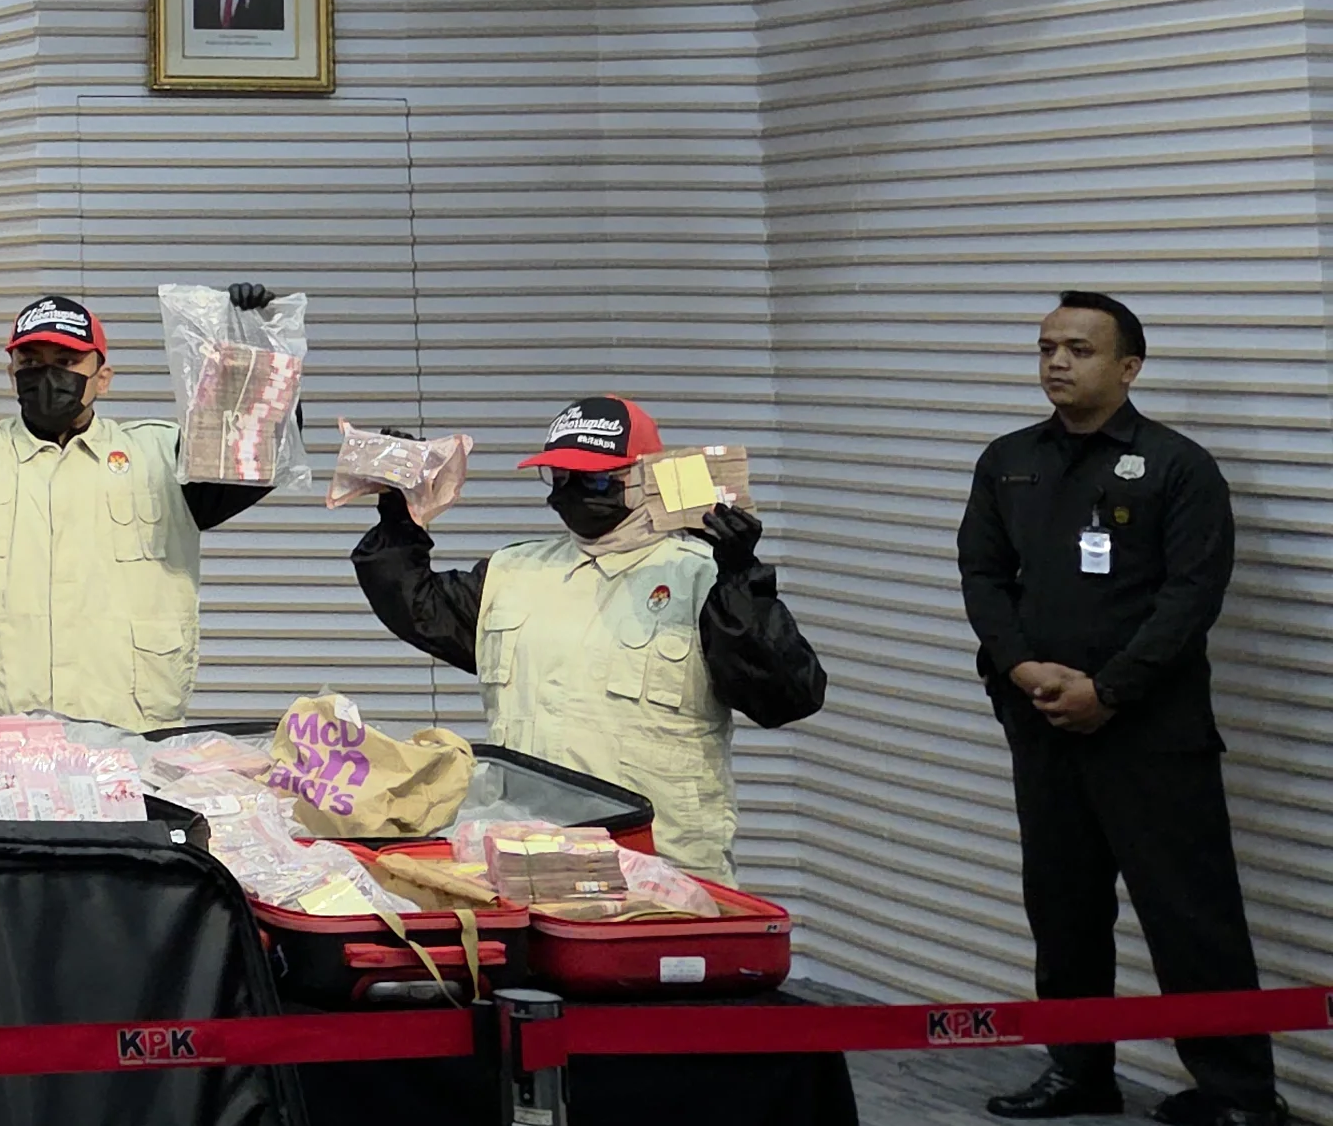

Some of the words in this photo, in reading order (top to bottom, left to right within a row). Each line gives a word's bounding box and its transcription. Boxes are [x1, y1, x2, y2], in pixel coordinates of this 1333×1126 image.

[286, 712, 366, 748] McD
[927, 1008, 997, 1038] KPK
[117, 1027, 197, 1059] KPK
